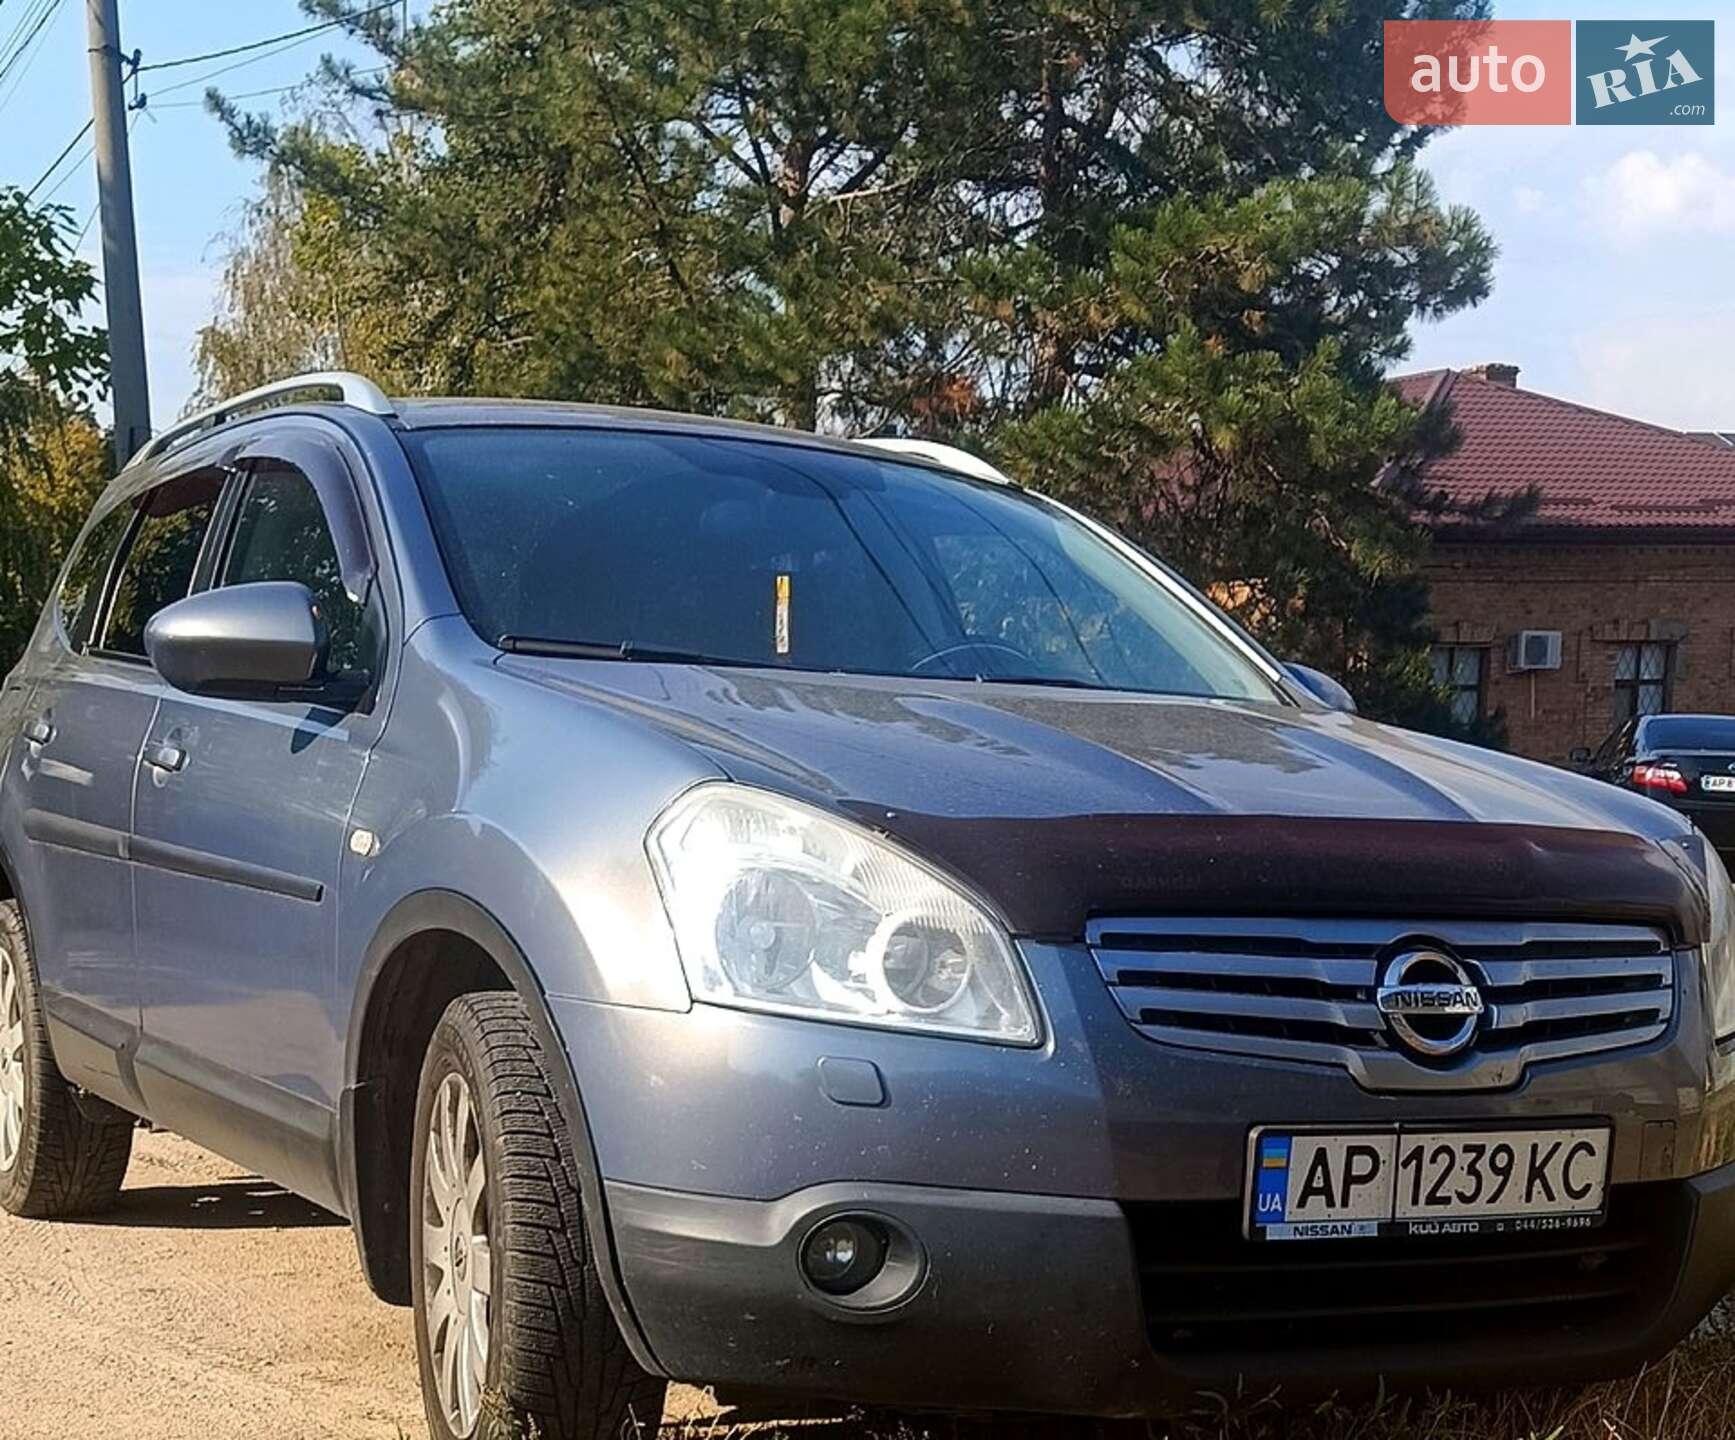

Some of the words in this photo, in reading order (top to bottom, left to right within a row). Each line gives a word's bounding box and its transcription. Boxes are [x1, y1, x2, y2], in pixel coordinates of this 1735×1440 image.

[1395, 991, 1478, 1008] NISSAN
[1296, 1145, 1382, 1210] AP
[1401, 1142, 1515, 1207] 1239
[1525, 1141, 1597, 1204] KC
[1258, 1193, 1283, 1213] UA
[1293, 1223, 1353, 1237] NISSAN
